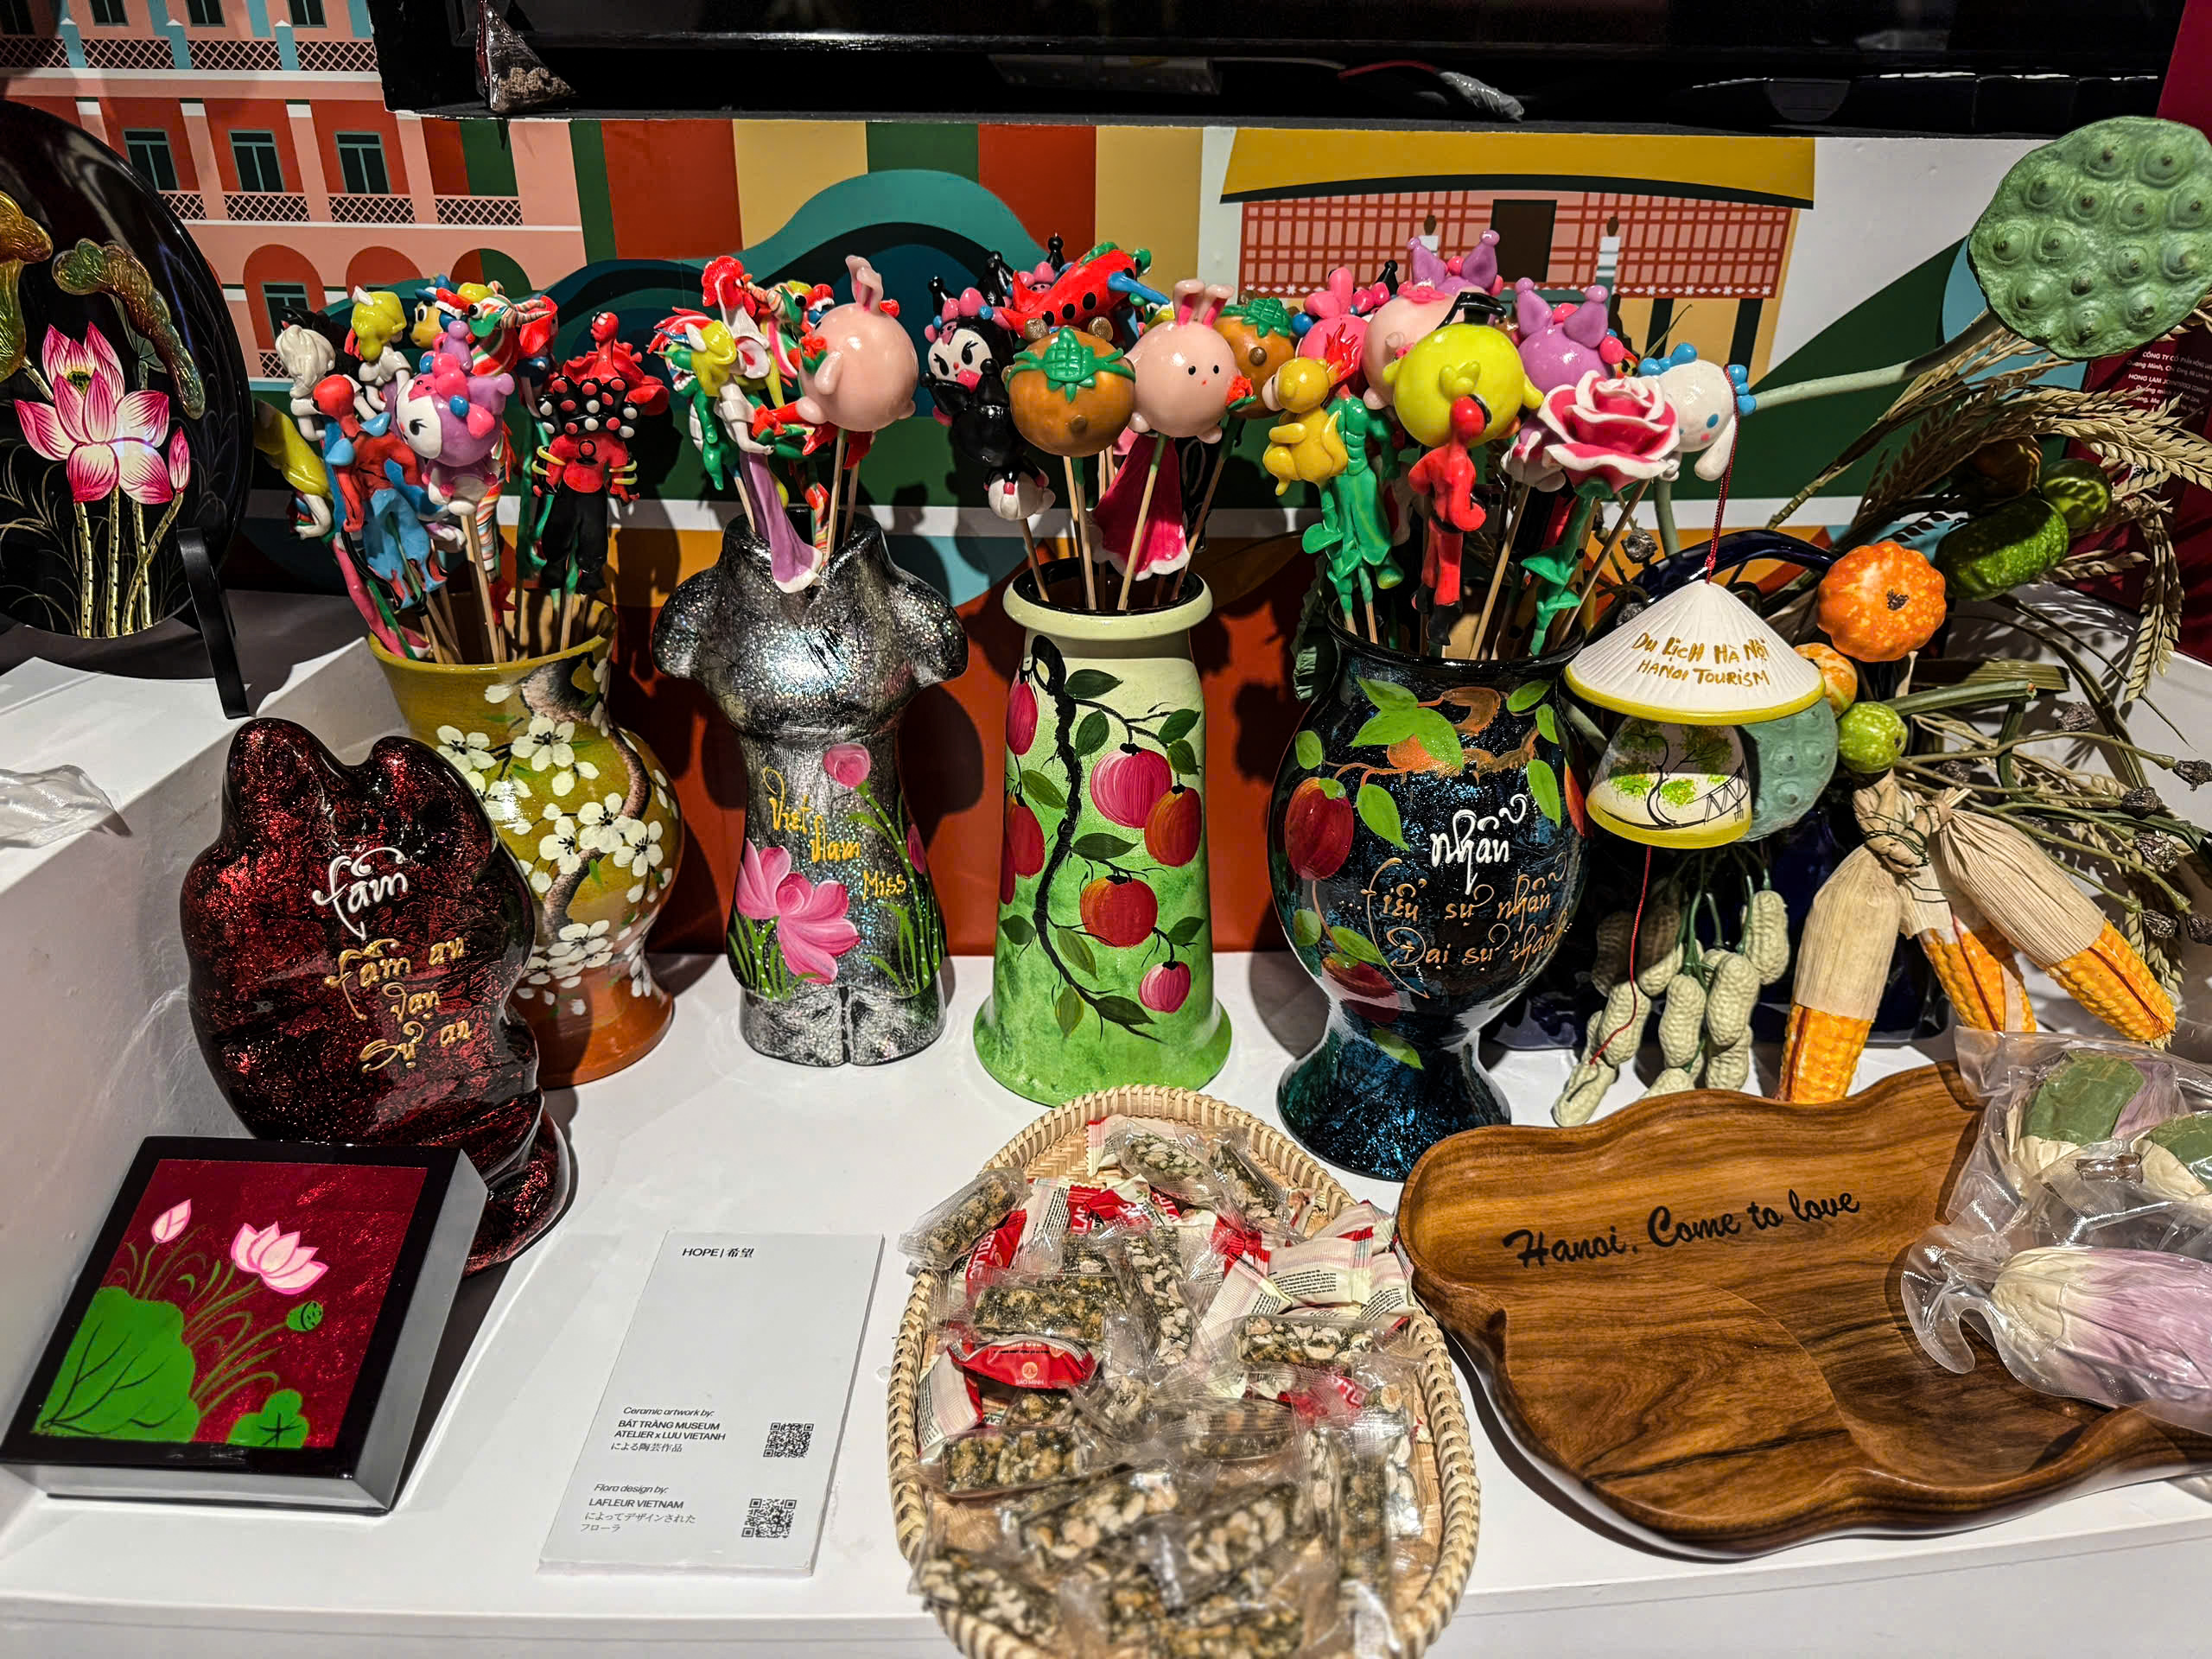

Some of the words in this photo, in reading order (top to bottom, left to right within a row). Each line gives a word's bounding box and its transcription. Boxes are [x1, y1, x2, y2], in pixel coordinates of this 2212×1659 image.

[862, 870, 907, 900] Miss
[1647, 1205, 1741, 1249] Come
[1748, 1201, 1785, 1230] to
[1788, 1188, 1861, 1223] love
[682, 1248, 720, 1257] HOPE
[623, 1407, 663, 1415] Ceramic
[664, 1408, 699, 1417] artwork
[700, 1408, 715, 1418] by:
[675, 1421, 721, 1431] MUSEUM
[613, 1430, 654, 1439] ATELIER
[683, 1432, 727, 1441] VIETANH
[594, 1483, 620, 1492] Flora
[620, 1484, 653, 1495] design
[654, 1485, 670, 1495] by:
[588, 1498, 635, 1508] LAFLEUR
[637, 1499, 684, 1510] VIETNAM
[580, 1523, 621, 1533] フローラ
